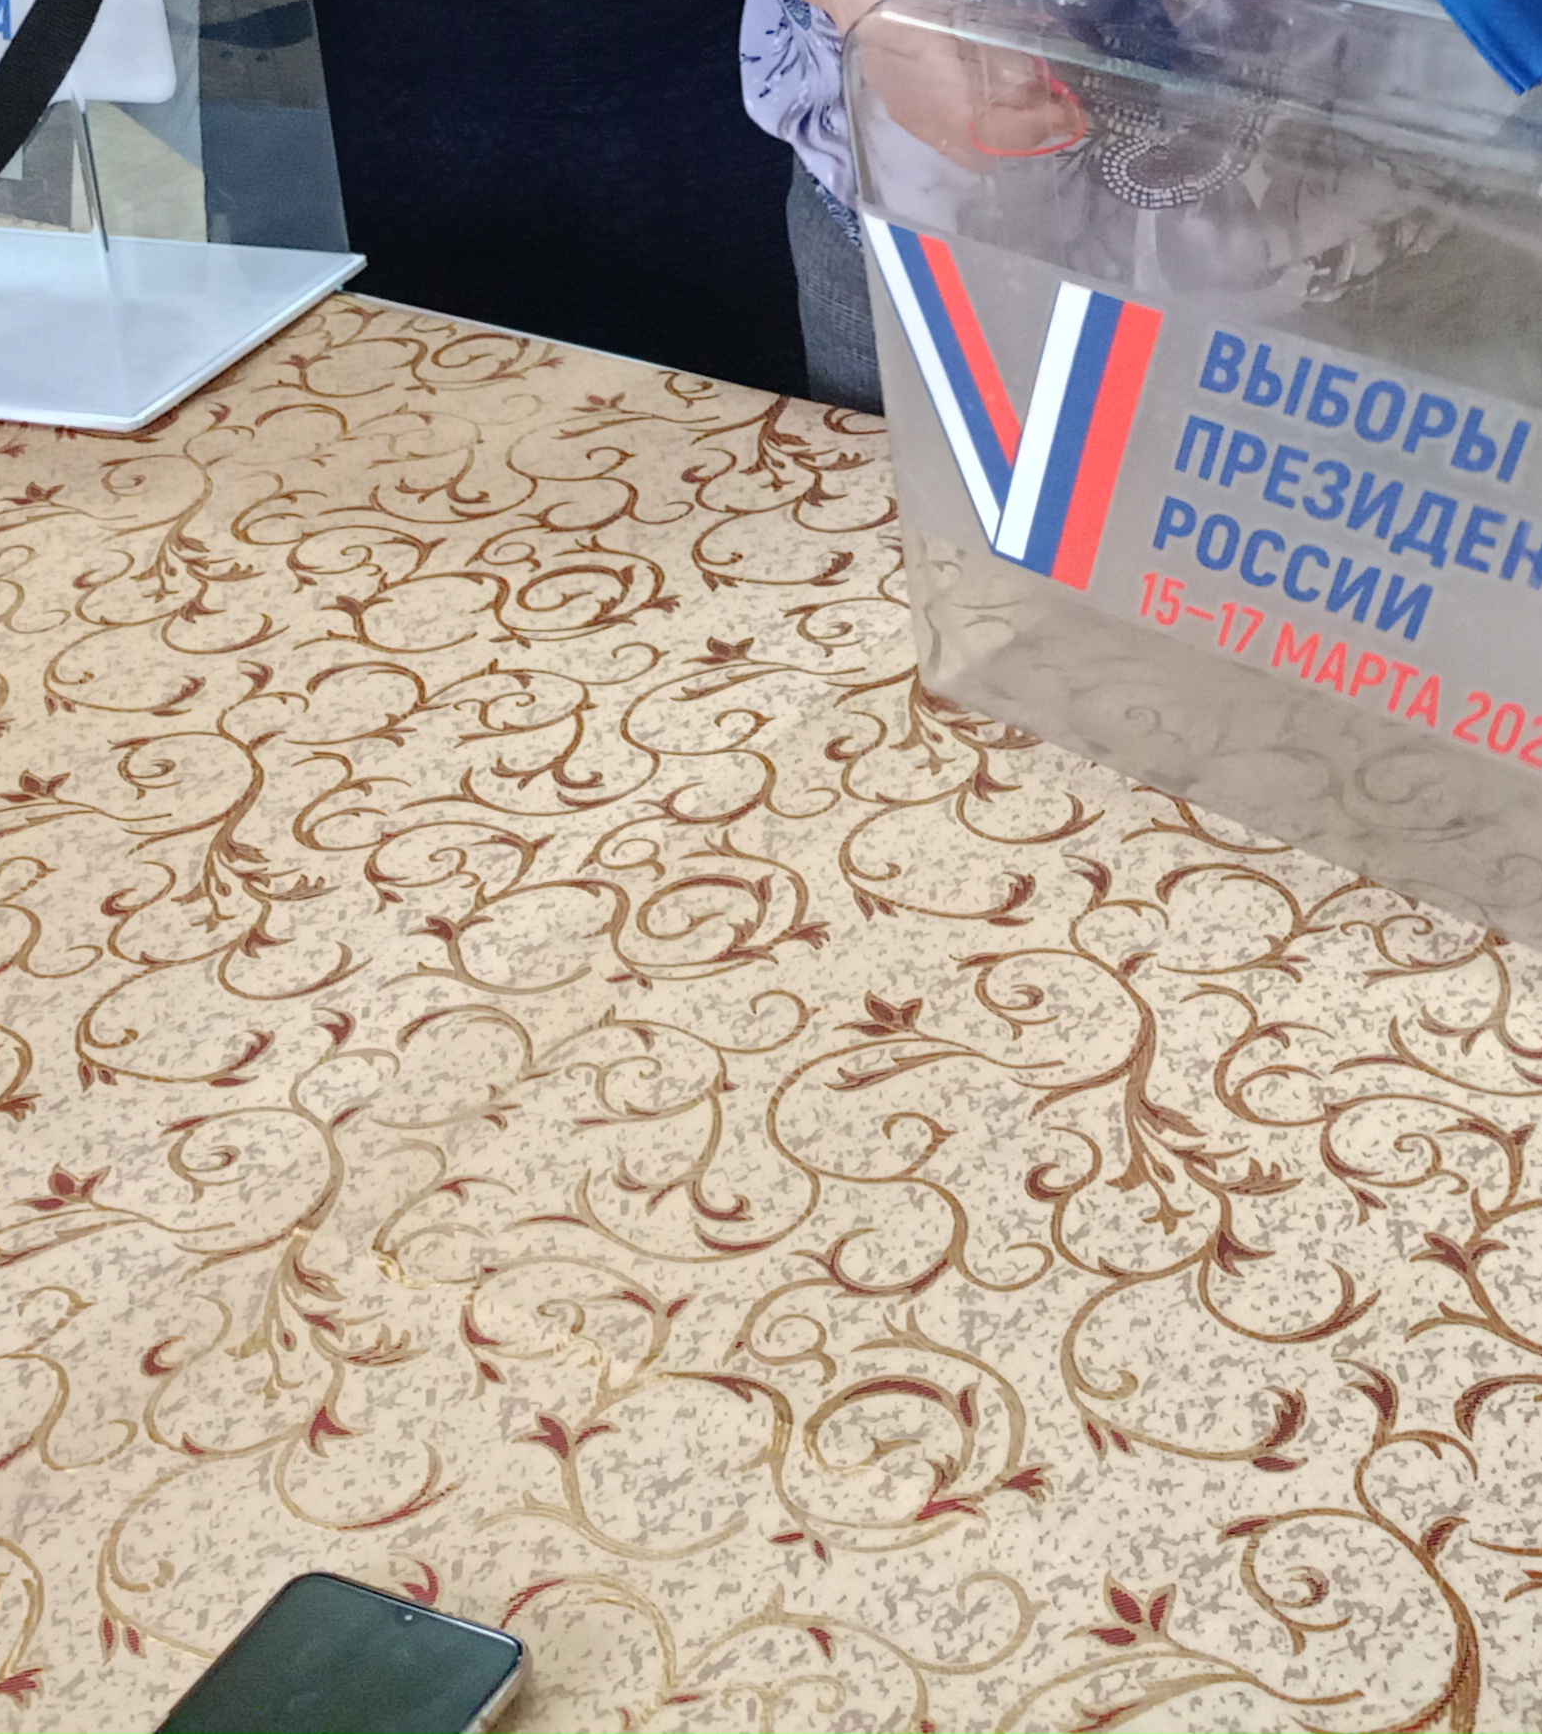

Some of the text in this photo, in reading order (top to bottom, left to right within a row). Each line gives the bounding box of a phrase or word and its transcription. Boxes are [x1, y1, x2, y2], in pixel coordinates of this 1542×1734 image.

[1200, 330, 1531, 483] ВЫБОРЫ
[1153, 496, 1434, 640] РОССИИ
[1270, 622, 1442, 729] МАРТА
